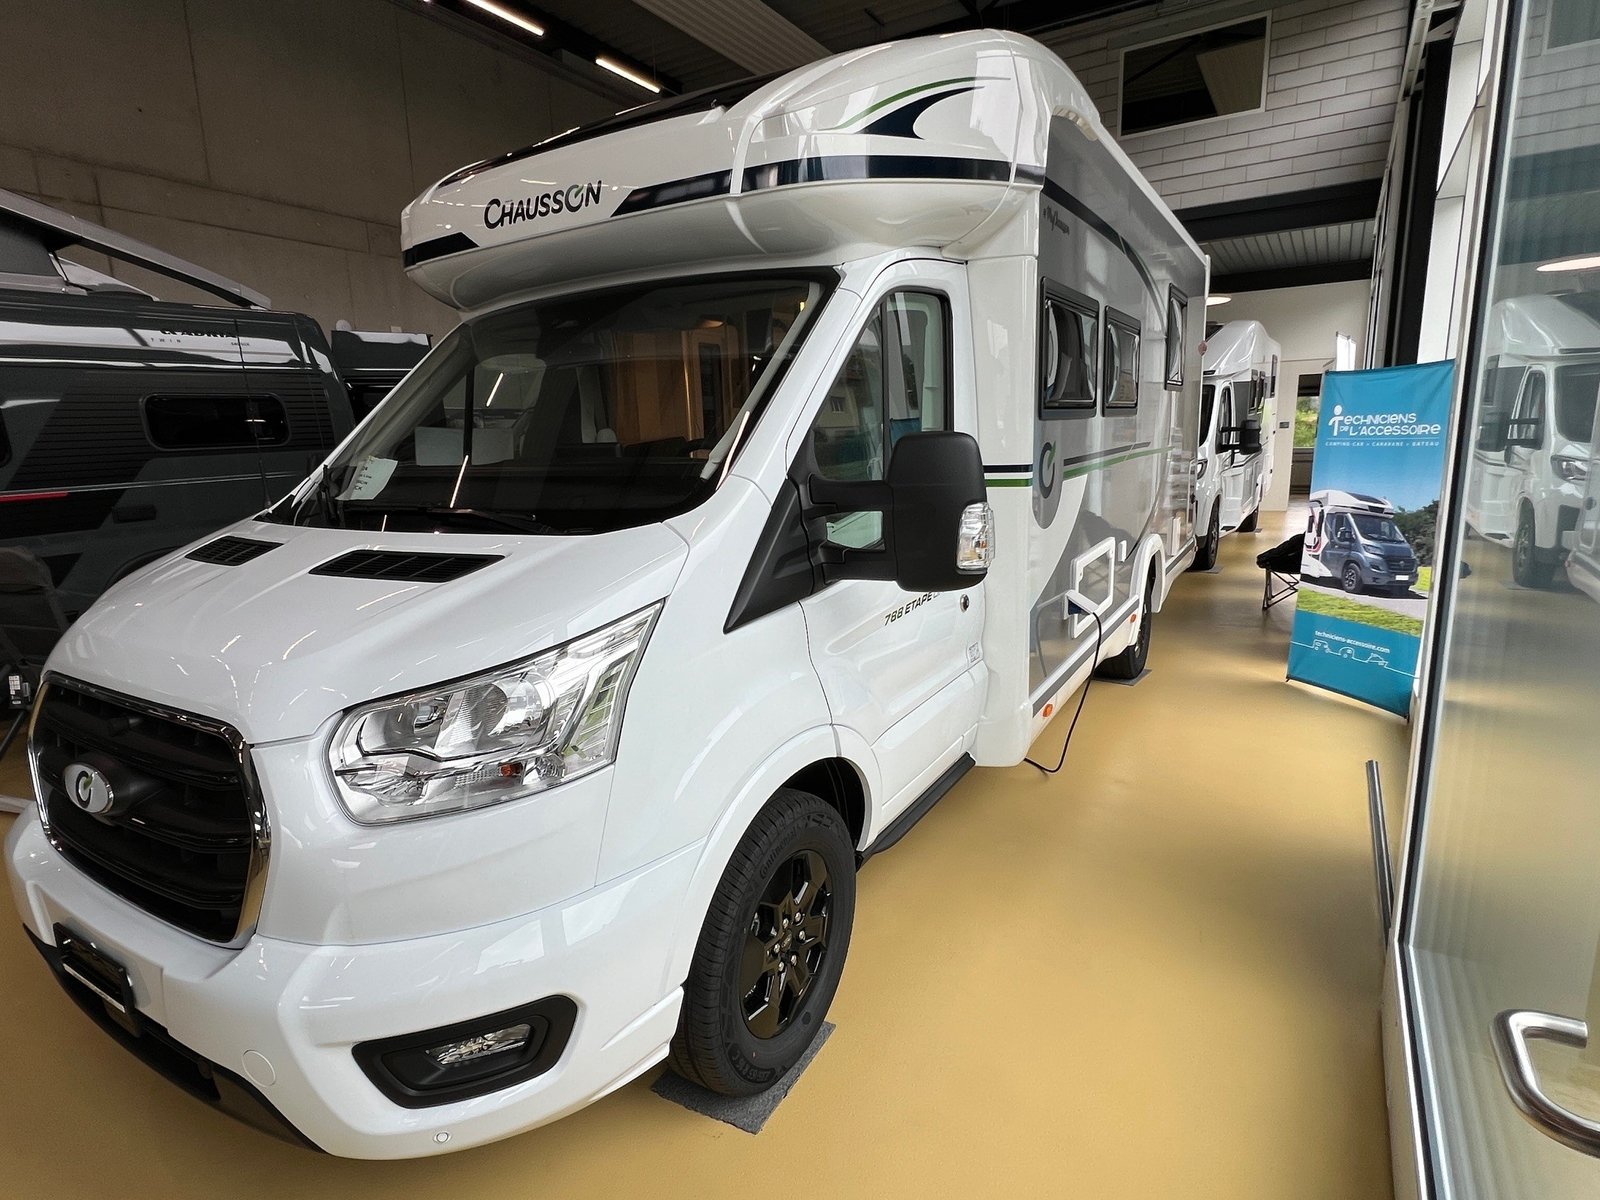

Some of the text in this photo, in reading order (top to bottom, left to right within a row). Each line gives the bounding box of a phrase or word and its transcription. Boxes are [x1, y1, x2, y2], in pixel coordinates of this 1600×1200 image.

[484, 180, 602, 230] CHAUSSON
[884, 591, 933, 627] 788 ETAPE
[1314, 630, 1391, 654] techniciens-accessoire.com
